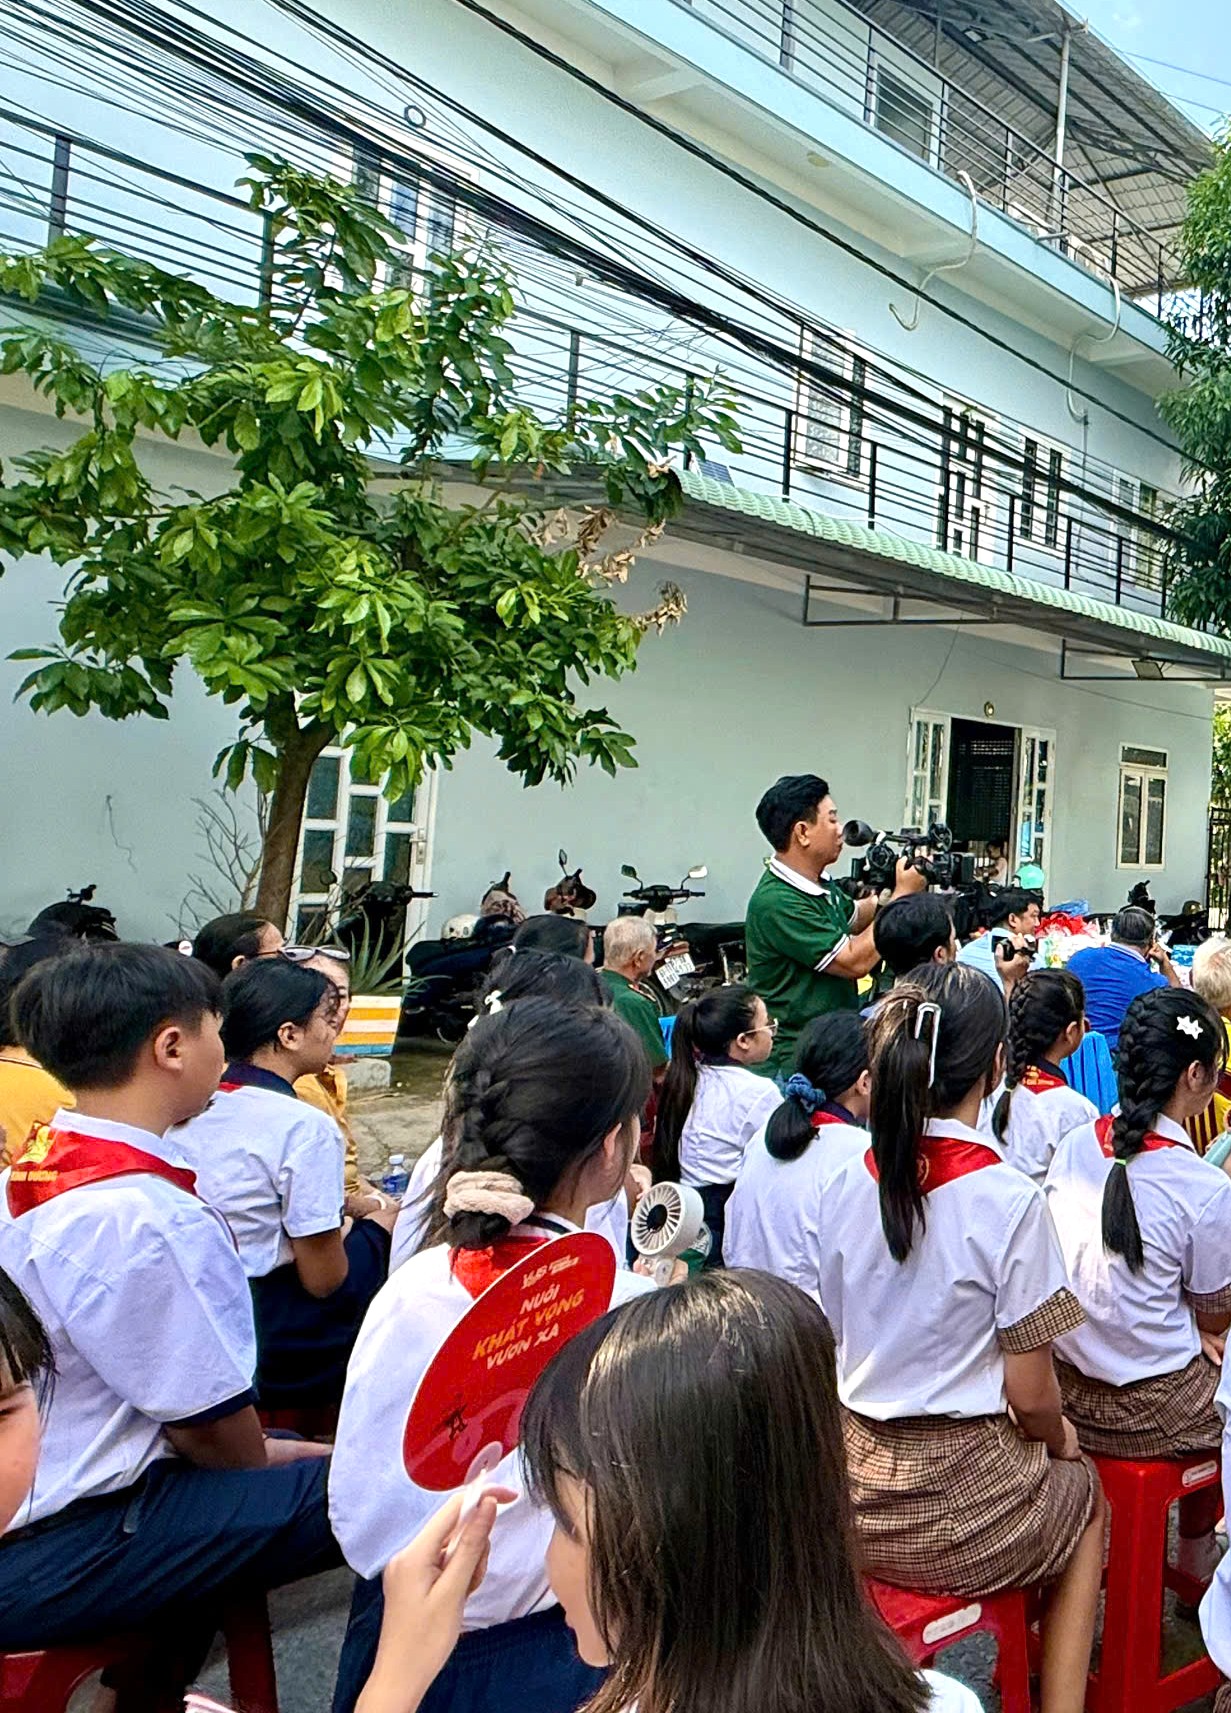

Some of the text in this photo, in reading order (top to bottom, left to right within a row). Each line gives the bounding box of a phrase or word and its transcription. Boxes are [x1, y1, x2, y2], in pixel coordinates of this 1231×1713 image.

[520, 1284, 560, 1314] NUÔI
[472, 1288, 585, 1361] KHÁT VỌNG
[533, 1323, 559, 1347] XA
